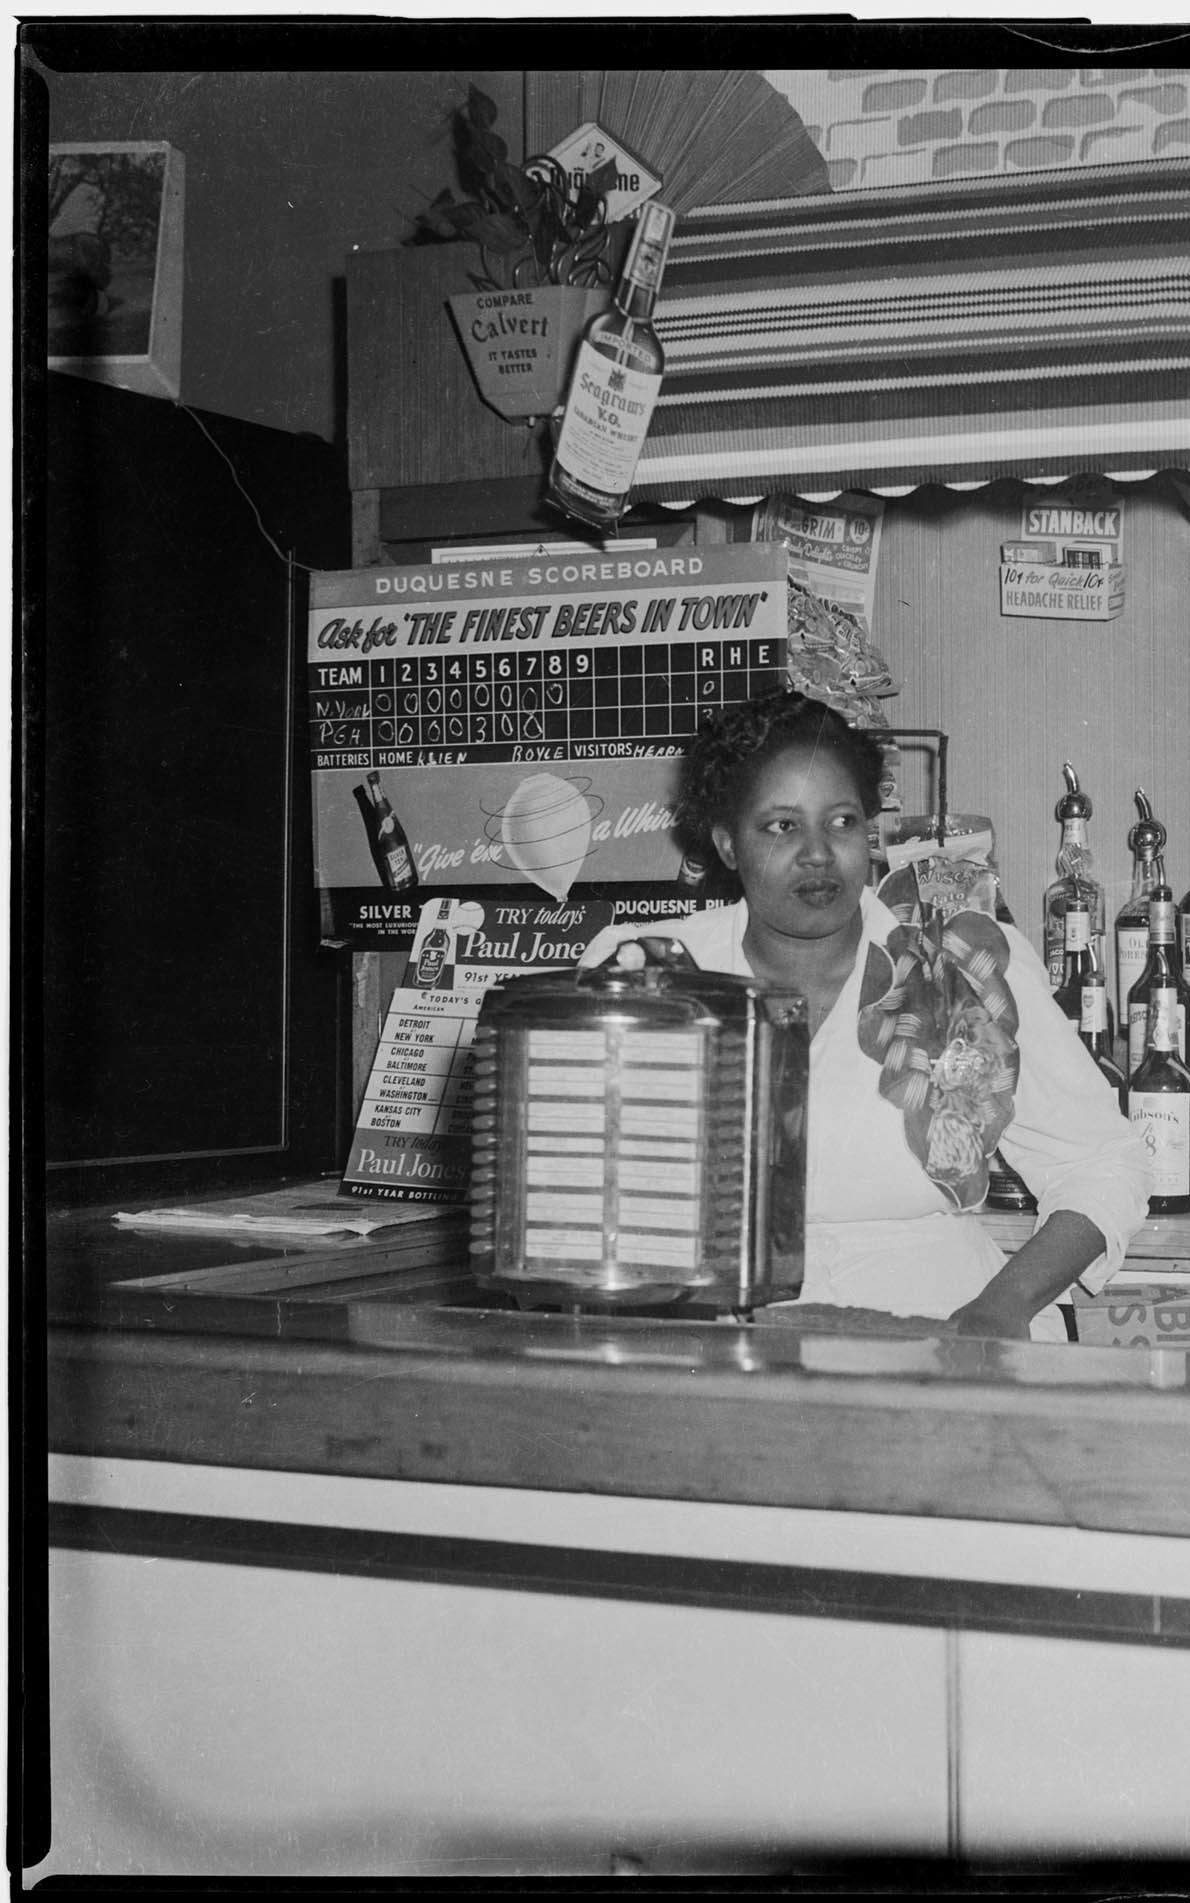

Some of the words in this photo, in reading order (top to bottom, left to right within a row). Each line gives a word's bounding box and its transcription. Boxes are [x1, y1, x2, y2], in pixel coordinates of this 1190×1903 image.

[476, 292, 534, 309] COMPARE
[471, 311, 548, 343] Calvert
[500, 348, 537, 360] TASTES
[498, 362, 533, 375] BETTER
[579, 371, 647, 416] Seagram's
[1028, 509, 1118, 536] STANBACK
[376, 569, 513, 595] DUQUESNE
[528, 557, 703, 584] SCOREBOARD
[1006, 591, 1064, 609] HEADACHE
[1066, 594, 1104, 611] RELIEF
[318, 617, 363, 650] Ask
[361, 616, 398, 654] for
[459, 605, 551, 643] FINEST
[551, 600, 638, 638] BEERS
[641, 598, 676, 633] IN
[317, 666, 362, 686] TEAM
[380, 665, 385, 683] 1
[401, 663, 412, 682] 2
[426, 662, 438, 681] 3
[450, 661, 462, 679] 4
[475, 660, 487, 679] 5
[499, 658, 511, 677] 6
[525, 657, 537, 676] 7
[549, 655, 562, 675] 8
[576, 654, 589, 673] 9
[702, 648, 714, 666] R
[730, 647, 741, 665] H
[758, 646, 769, 664] E
[375, 693, 392, 712] 0
[404, 692, 418, 714] 0
[427, 688, 441, 712] 0
[450, 688, 462, 709] 0
[475, 684, 489, 707] 0
[500, 685, 512, 707] 0
[378, 720, 394, 741] 0
[399, 722, 414, 744] 0
[450, 716, 463, 737] 0
[475, 716, 487, 743] 3
[501, 713, 513, 736] 0
[575, 742, 632, 757] VISITORS
[317, 753, 369, 767] BATTERIES
[379, 751, 413, 765] HOME
[592, 819, 611, 841] a
[360, 904, 412, 919] SILVER
[615, 899, 697, 915] DUQUESNE
[495, 907, 534, 925] TRY
[385, 921, 419, 929] LUXURIOU
[461, 930, 517, 959] Paul
[521, 931, 587, 963] Jone
[464, 971, 489, 982] 91st
[429, 994, 469, 1005] TODAY'S
[398, 1018, 431, 1029] DETROIT
[394, 1032, 411, 1041] NEW
[415, 1033, 434, 1043] YORK
[390, 1047, 425, 1058] CHICAGO
[386, 1060, 428, 1072] BALTIMORE
[382, 1075, 426, 1087] CLEVELAND
[379, 1089, 428, 1101] WASHINGTON
[374, 1104, 403, 1115] KANSAS
[404, 1106, 422, 1116] CITY
[370, 1117, 402, 1128] BOSTON
[384, 1135, 409, 1149] TRY
[1145, 1134, 1157, 1157] 8
[356, 1148, 407, 1176] Paul
[351, 1185, 373, 1195] 91st
[377, 1188, 404, 1199] YEAR
